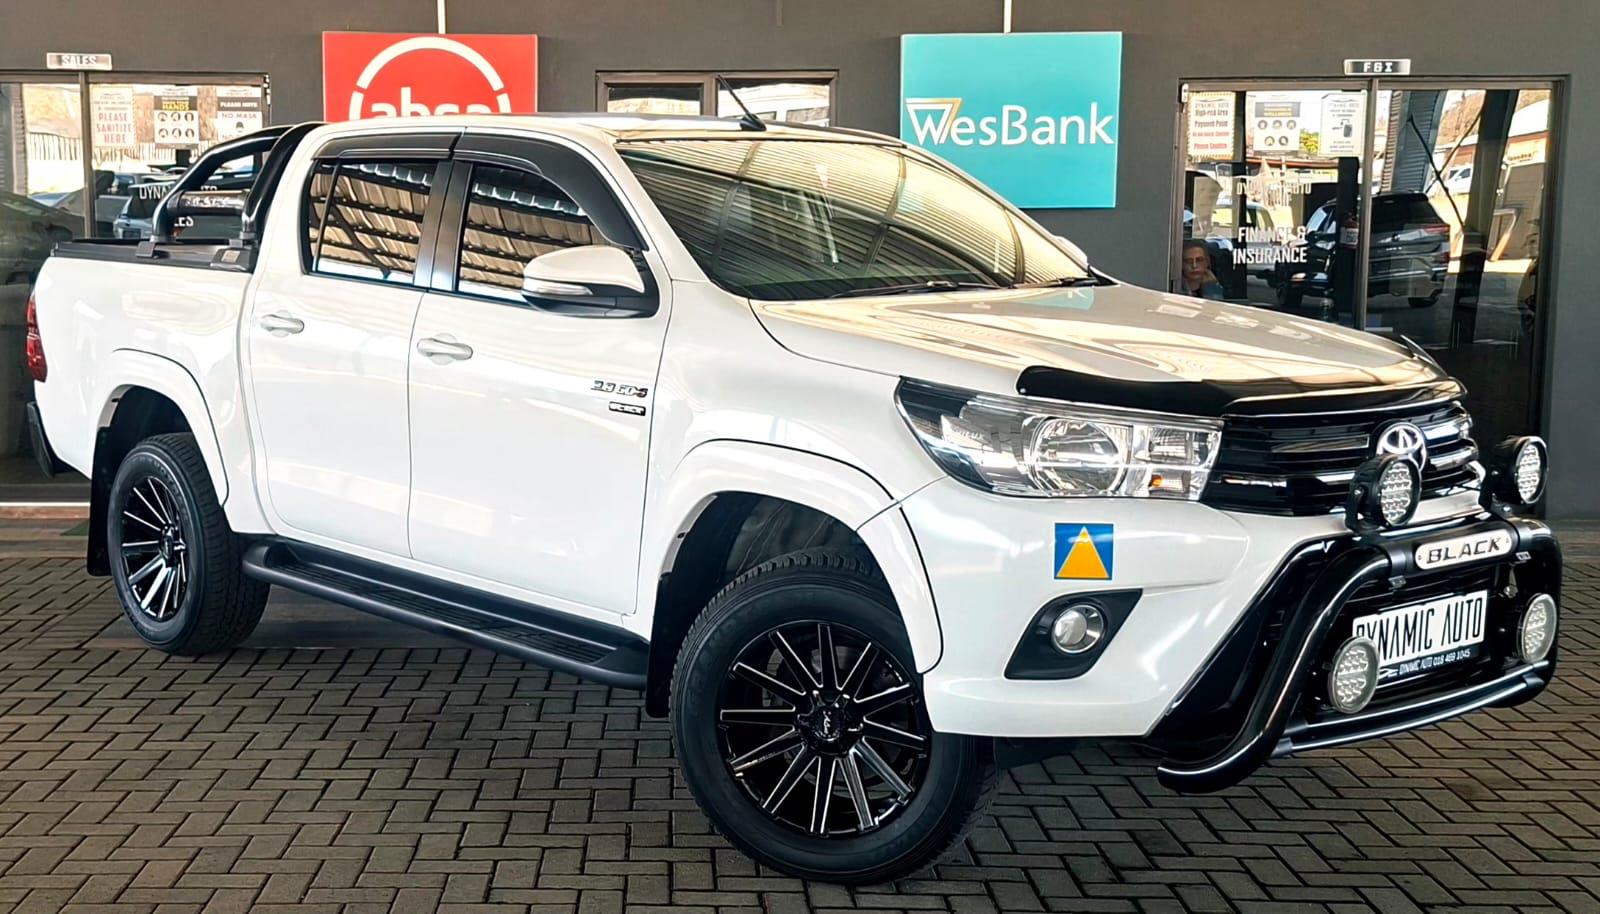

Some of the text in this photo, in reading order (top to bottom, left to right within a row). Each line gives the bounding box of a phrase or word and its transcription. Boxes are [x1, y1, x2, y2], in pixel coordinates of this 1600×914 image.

[62, 55, 97, 66] SALES
[98, 112, 128, 121] PLEASE
[905, 97, 1115, 146] WesBank
[96, 123, 132, 133] SANITIZE
[103, 134, 126, 143] HERE
[1233, 246, 1308, 265] INSURANCE
[1426, 536, 1502, 565] BLACK
[1441, 597, 1483, 647] AUTO
